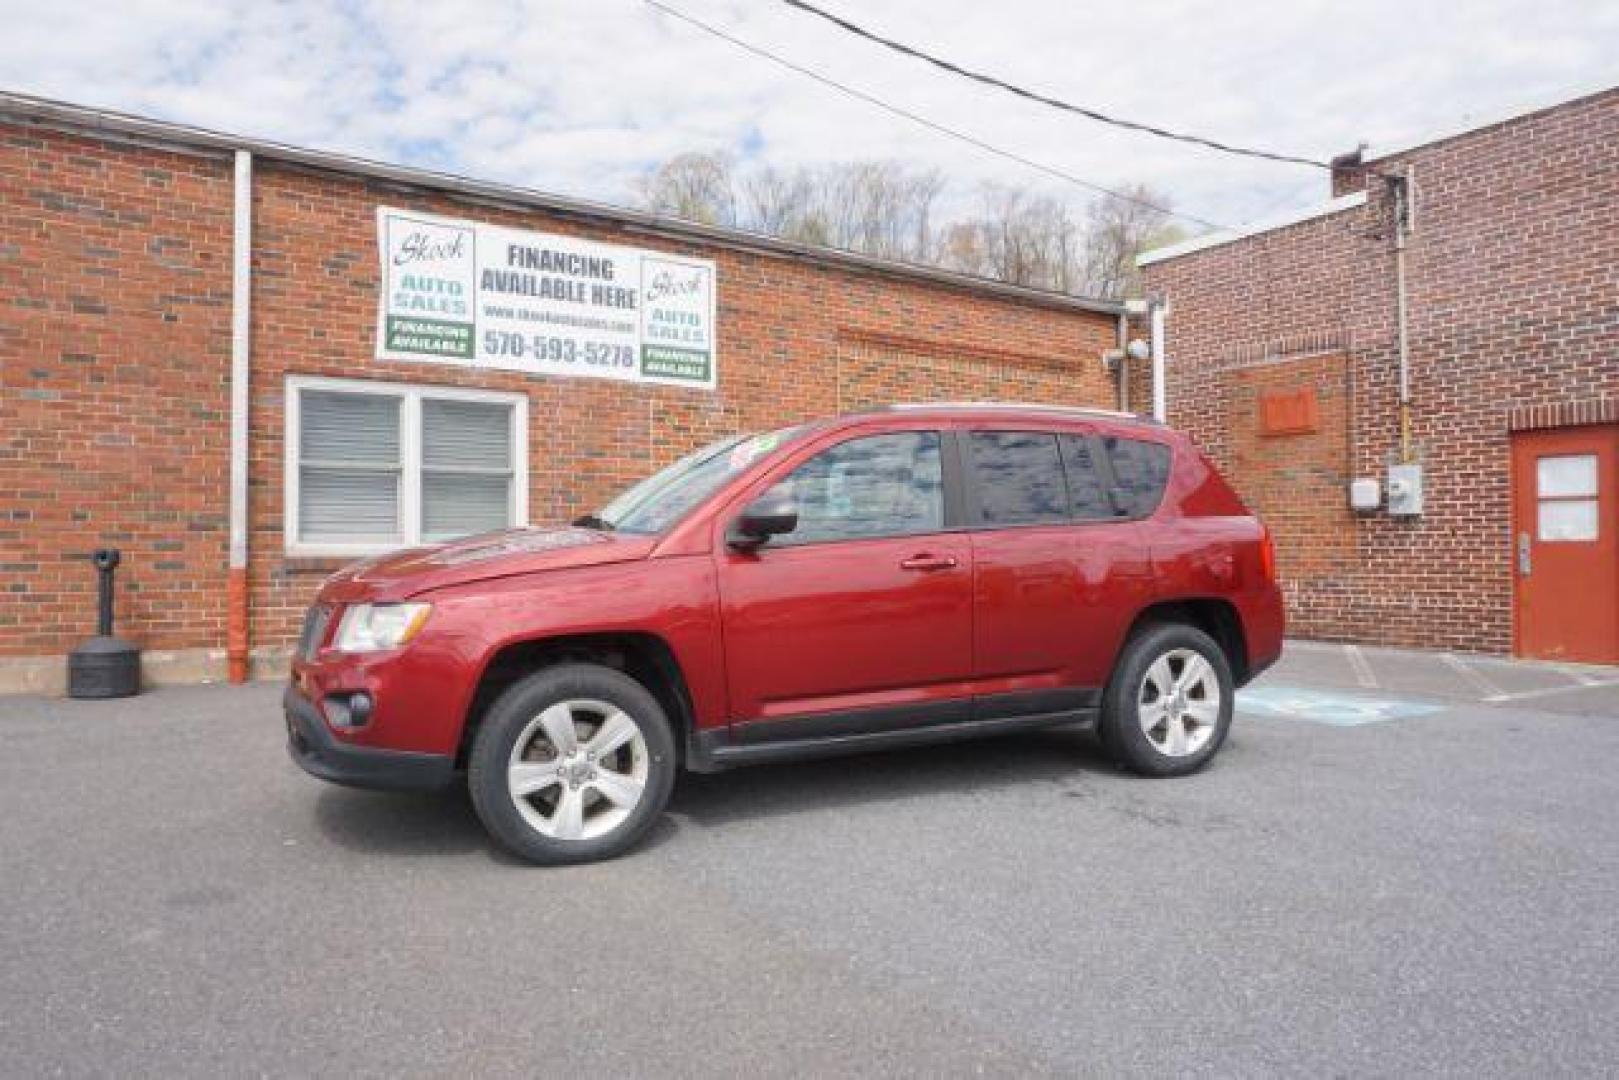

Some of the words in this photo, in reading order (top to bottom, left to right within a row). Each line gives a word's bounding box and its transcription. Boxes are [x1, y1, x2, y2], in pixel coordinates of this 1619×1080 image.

[508, 244, 614, 281] FINANCING
[401, 274, 463, 297] AUTO
[480, 268, 585, 304] AVAILABLE
[591, 284, 637, 310] HERE
[394, 292, 466, 314] SALES
[653, 308, 700, 326] AUTO
[648, 324, 704, 341] SALES
[485, 329, 634, 367] 570-593-5278
